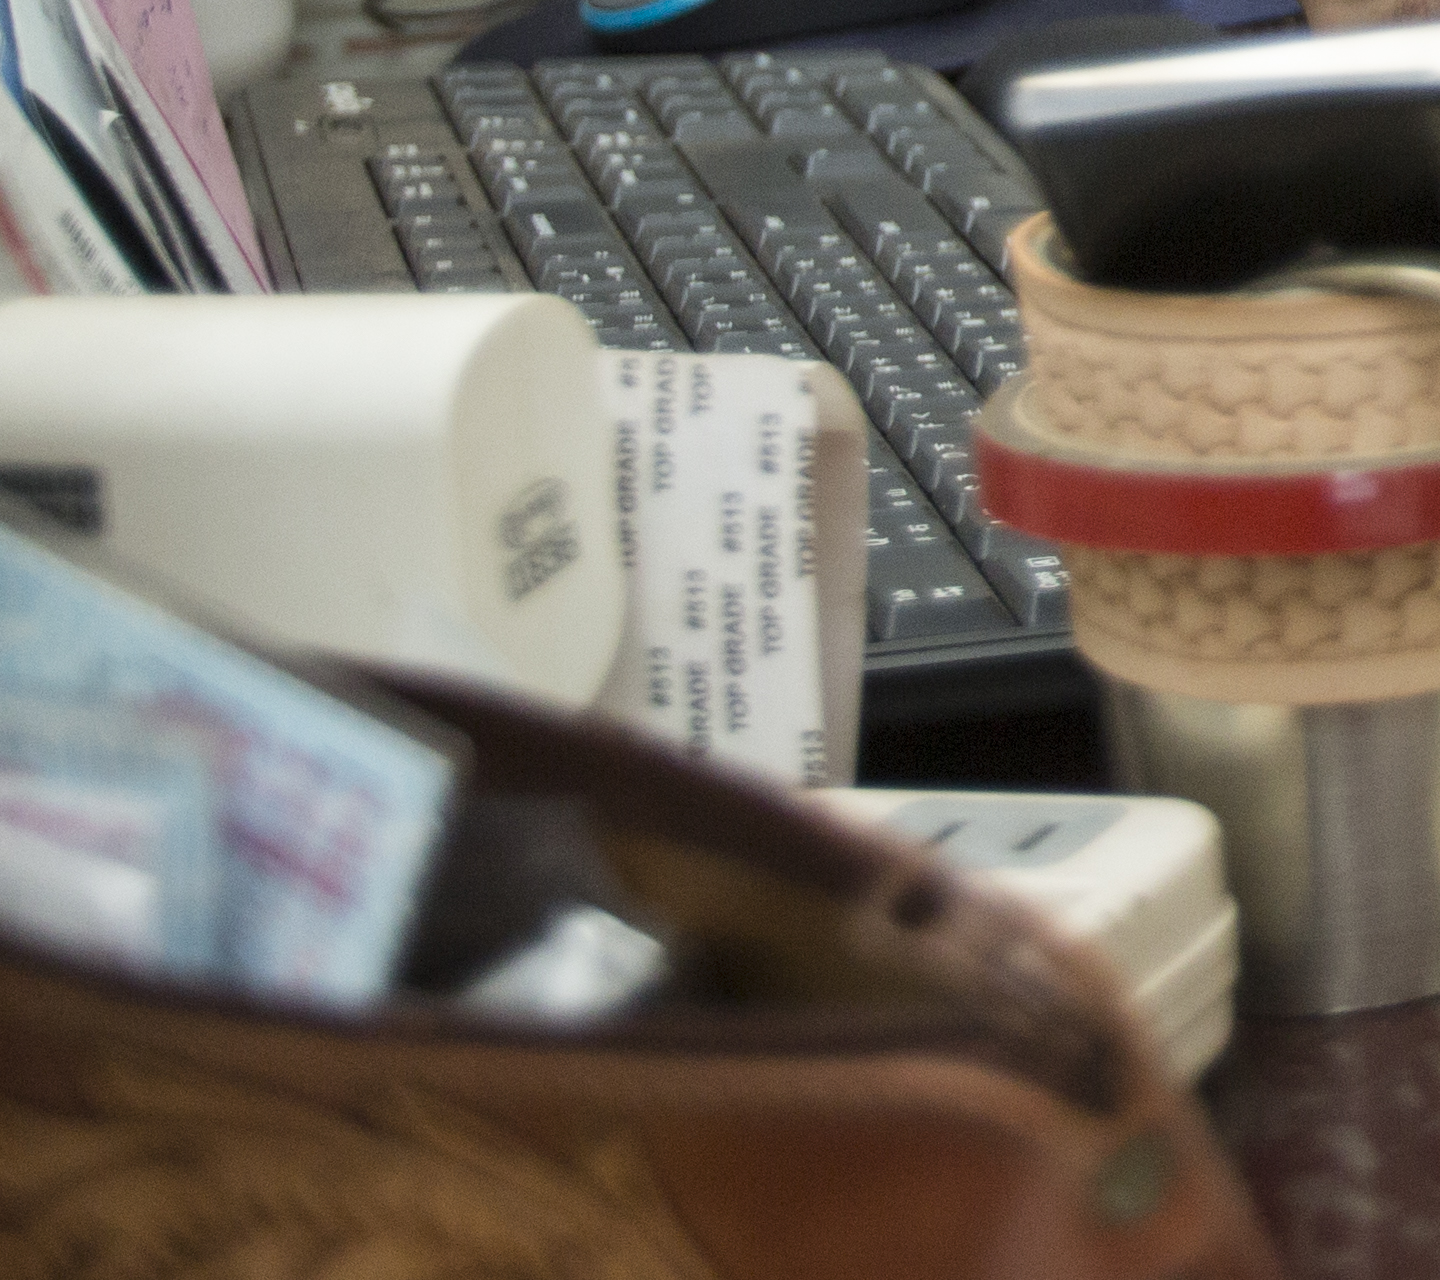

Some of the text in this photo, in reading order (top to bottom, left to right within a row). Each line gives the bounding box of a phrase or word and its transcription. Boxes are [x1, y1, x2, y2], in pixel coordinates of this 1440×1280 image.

[690, 364, 712, 415] TOP
[652, 441, 675, 493] TOP
[758, 507, 781, 598] GRADE
[722, 584, 748, 675] GRADE
[761, 605, 783, 655] TOP
[726, 682, 749, 731] TOP
